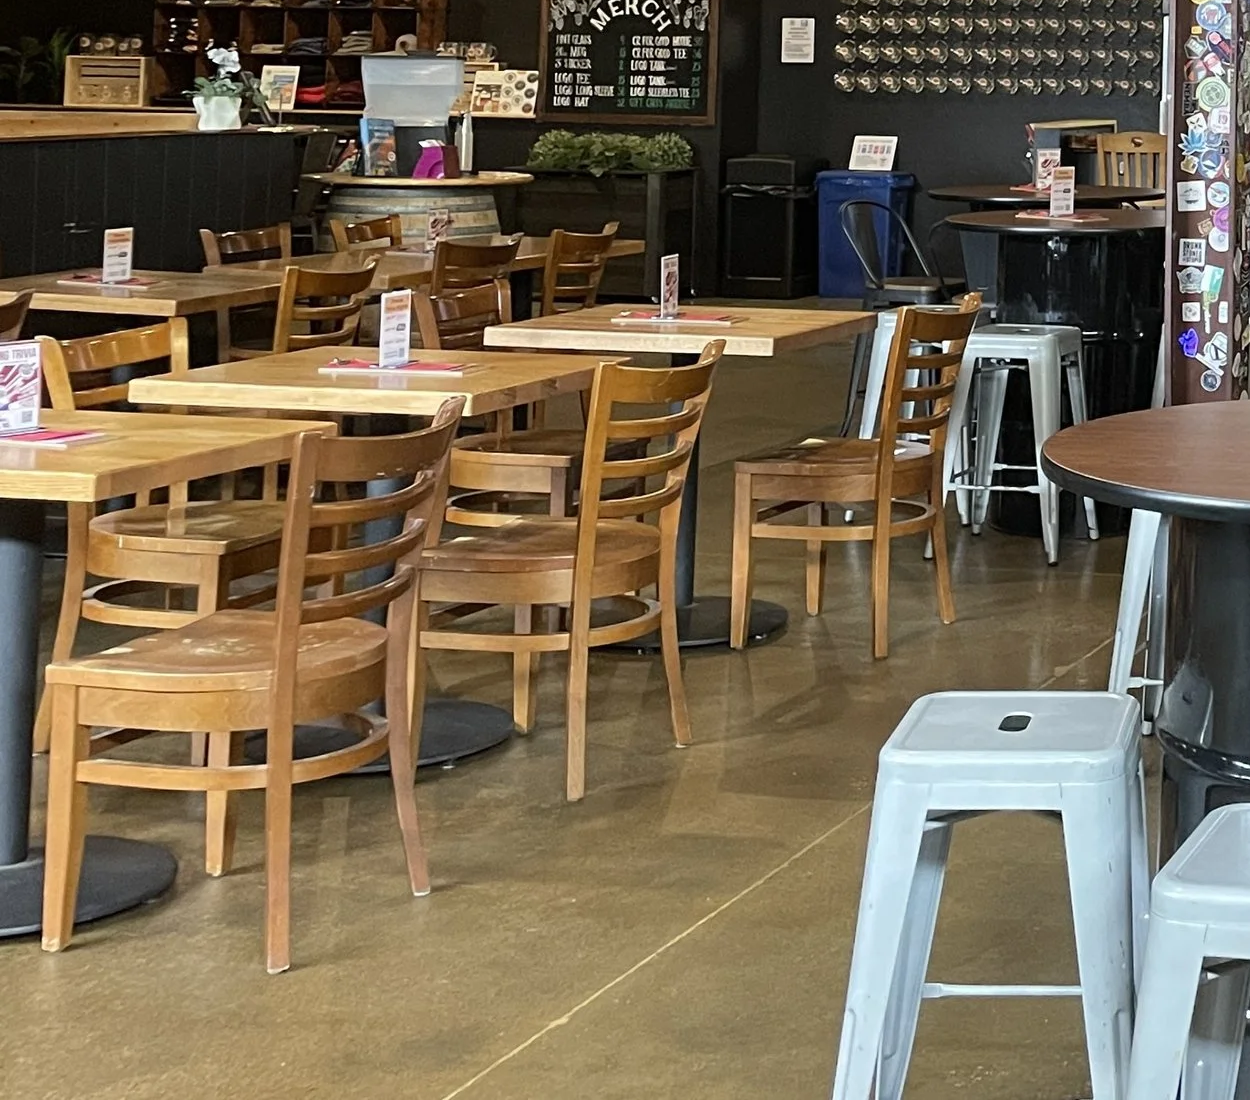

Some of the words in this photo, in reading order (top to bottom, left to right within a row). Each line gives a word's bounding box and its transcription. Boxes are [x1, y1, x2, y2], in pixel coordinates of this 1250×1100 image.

[630, 60, 648, 71] LOGO
[554, 72, 574, 83] LOGO
[576, 72, 591, 84] TEE
[554, 84, 574, 95] LOGO
[553, 95, 571, 106] LOGO
[574, 96, 590, 107] HAT
[12, 347, 37, 360] TRIVIA
